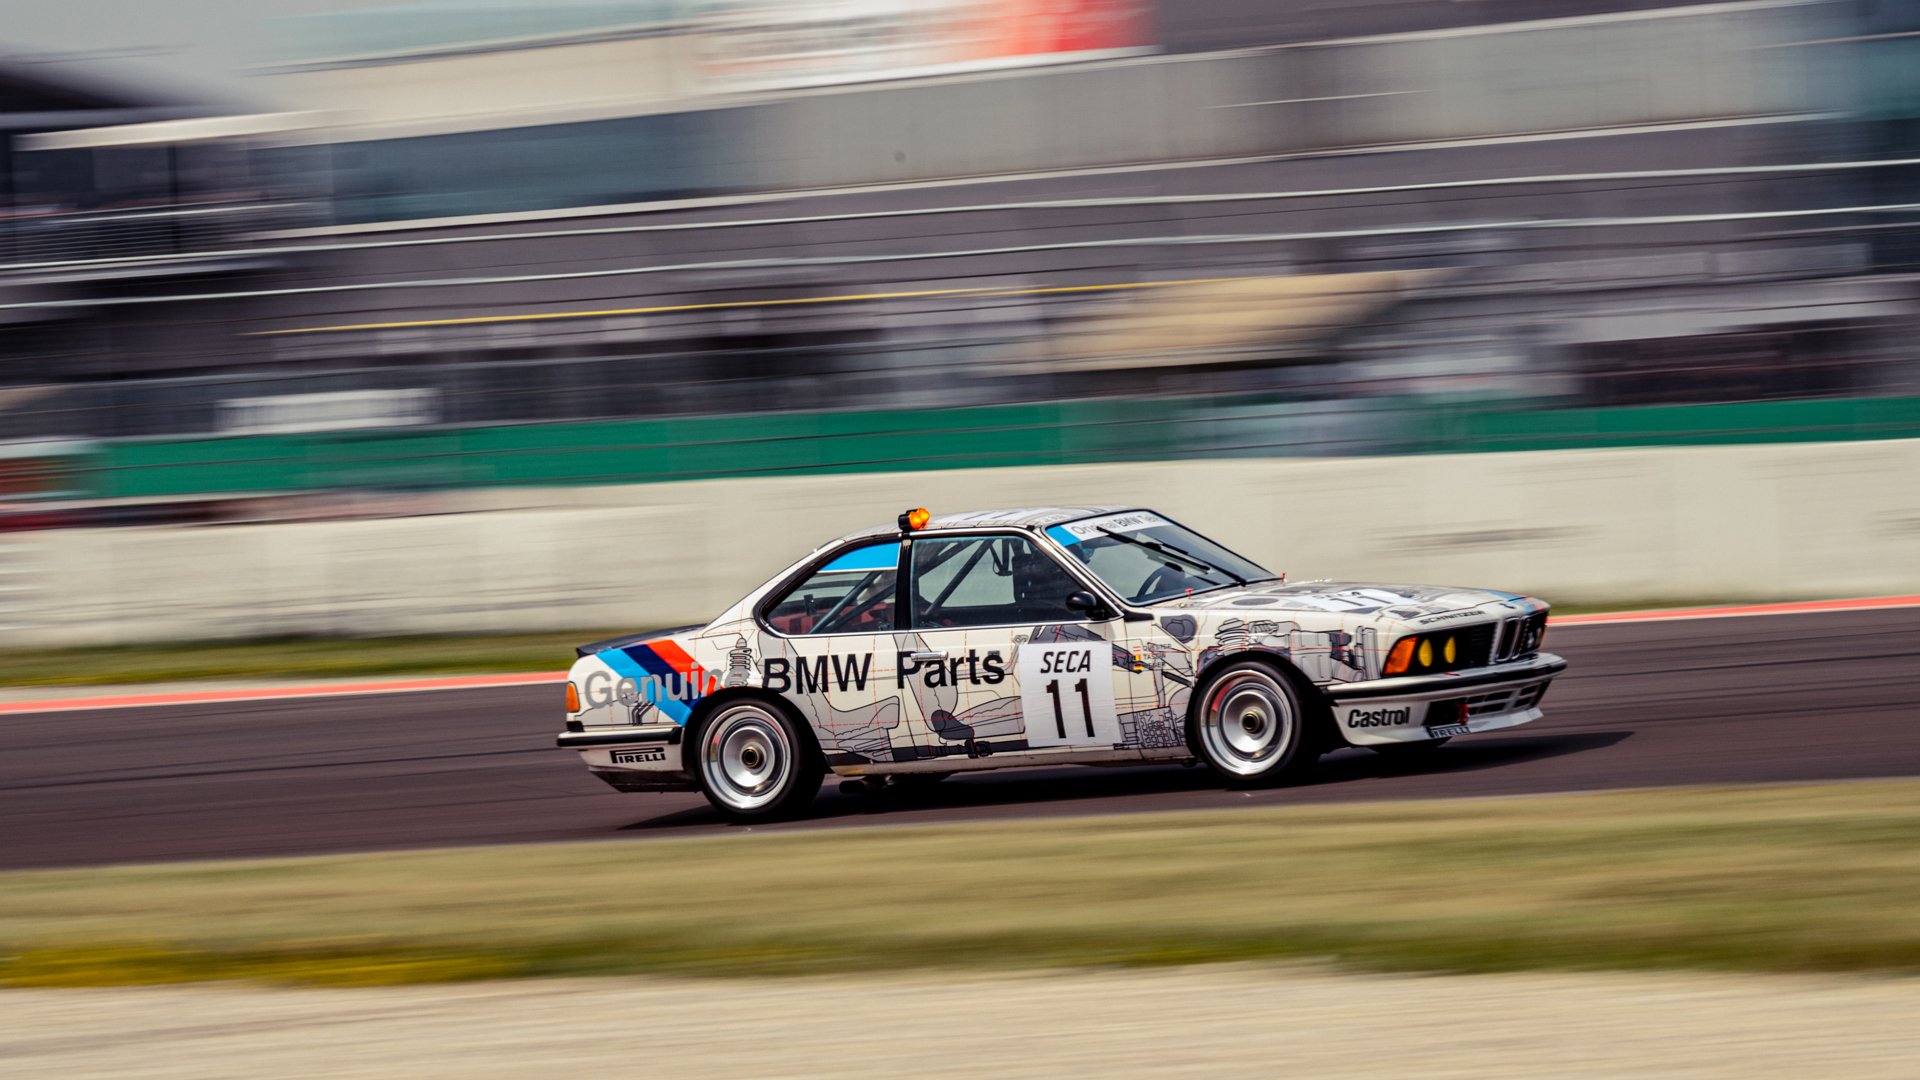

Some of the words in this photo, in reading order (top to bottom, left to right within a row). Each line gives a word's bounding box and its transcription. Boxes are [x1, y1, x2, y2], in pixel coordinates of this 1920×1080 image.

[1113, 514, 1144, 527] BMW
[763, 652, 873, 694] BMW
[897, 649, 1005, 689] Parts
[1040, 650, 1091, 674] SECA
[1046, 678, 1095, 739] 11
[1348, 706, 1411, 728] Castrol
[1425, 725, 1471, 739] PIRELLI
[610, 747, 666, 764] PIRELLI
